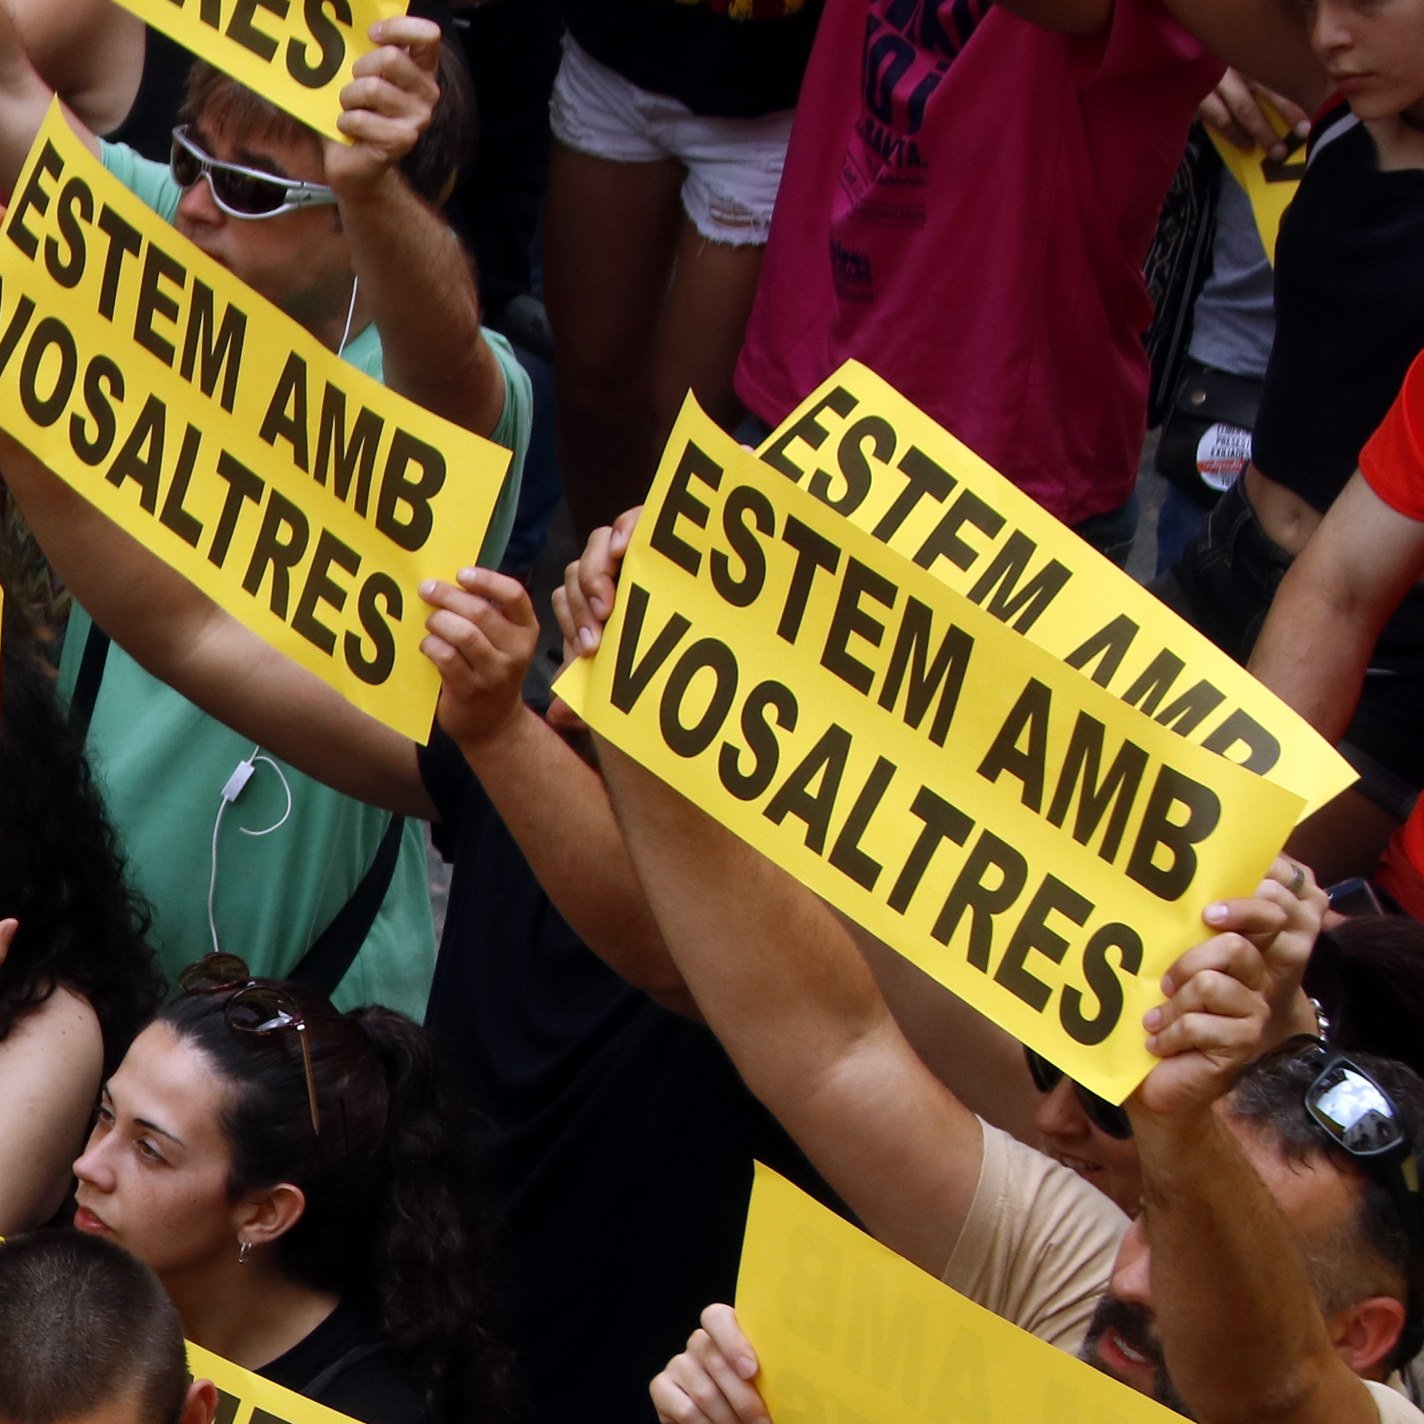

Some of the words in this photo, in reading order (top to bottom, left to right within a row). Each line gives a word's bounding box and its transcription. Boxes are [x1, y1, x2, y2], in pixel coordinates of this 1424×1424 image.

[5, 139, 249, 415] ESTEM
[258, 349, 447, 553] AMB
[609, 581, 1144, 1046] VOSALTRES
[649, 438, 975, 749] ESTEM
[977, 676, 1224, 902] AMB
